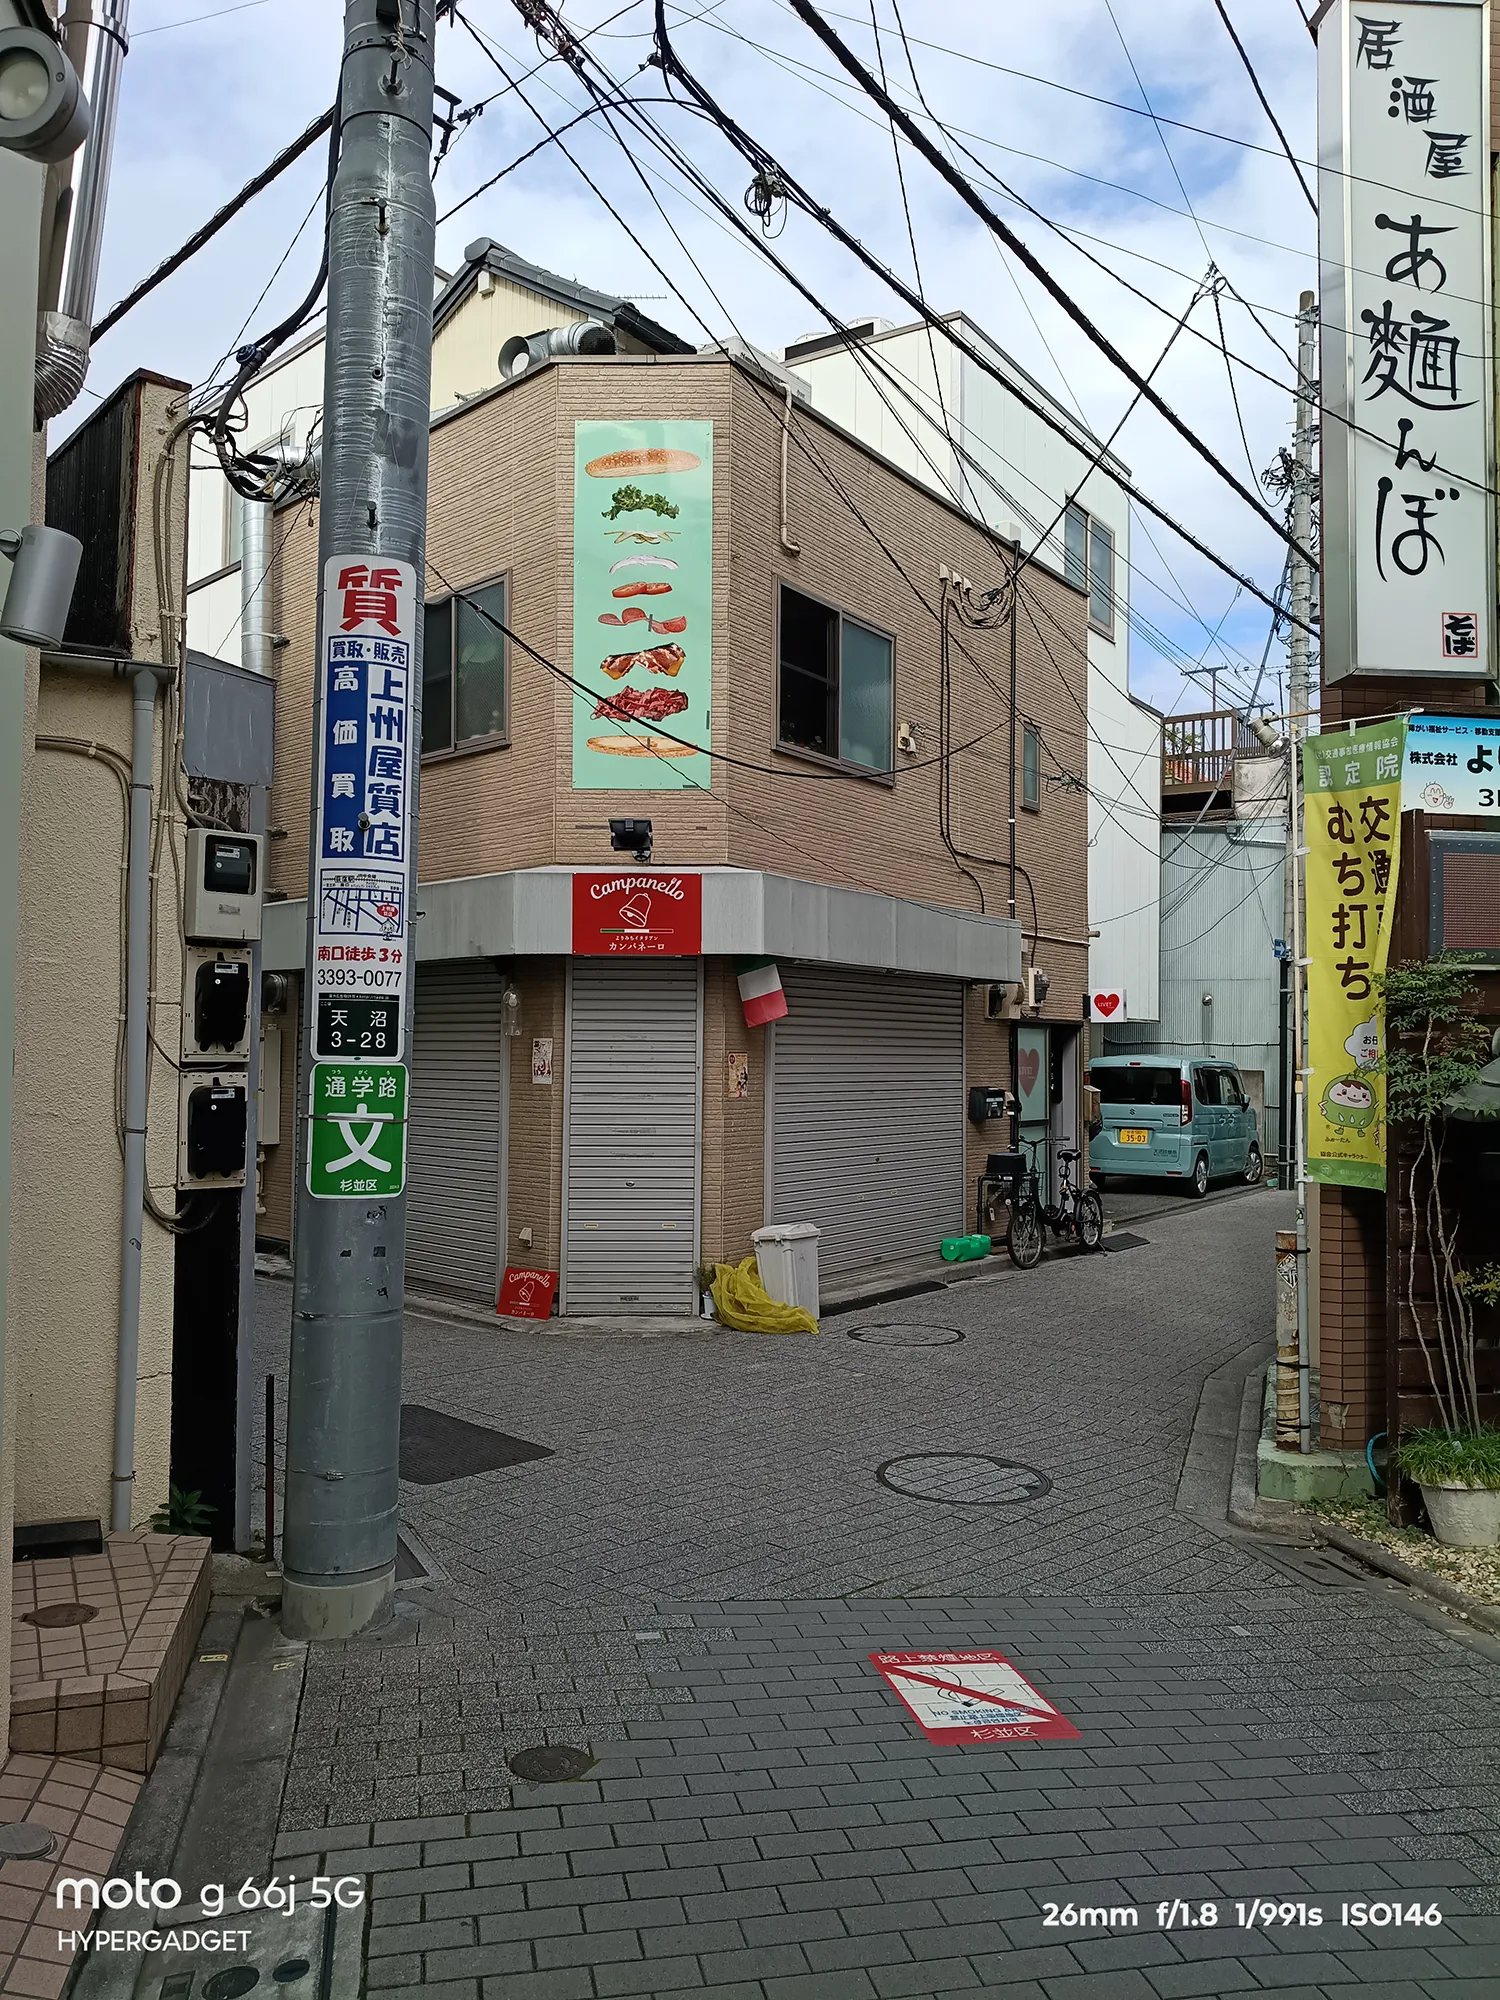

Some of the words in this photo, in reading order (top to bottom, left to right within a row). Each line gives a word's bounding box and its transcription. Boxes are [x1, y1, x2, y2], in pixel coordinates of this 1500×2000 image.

[1354, 15, 1474, 179] 居酒屋
[337, 564, 403, 637] 質
[1444, 614, 1476, 656] そば
[332, 640, 406, 665] 買取・販売
[329, 665, 359, 852] 高価買取
[365, 669, 404, 857] 上州屋質店
[1410, 751, 1458, 766] 株式会社
[590, 876, 685, 901] Campanello
[1327, 801, 1373, 1000] むち打ち
[317, 945, 403, 964] 南口徒歩3分
[317, 969, 402, 988] 3393-0077
[331, 1031, 386, 1049] 3-28
[325, 1076, 397, 1098] 通学路
[325, 1103, 394, 1173] 文
[340, 1179, 378, 1192] 杉並区
[508, 1271, 551, 1288] Campanello
[877, 1652, 1000, 1664] 路上禁煙地区
[932, 1710, 949, 1718] NO
[951, 1707, 1002, 1716] SMOKING
[970, 1726, 1040, 1740] 杉並区
